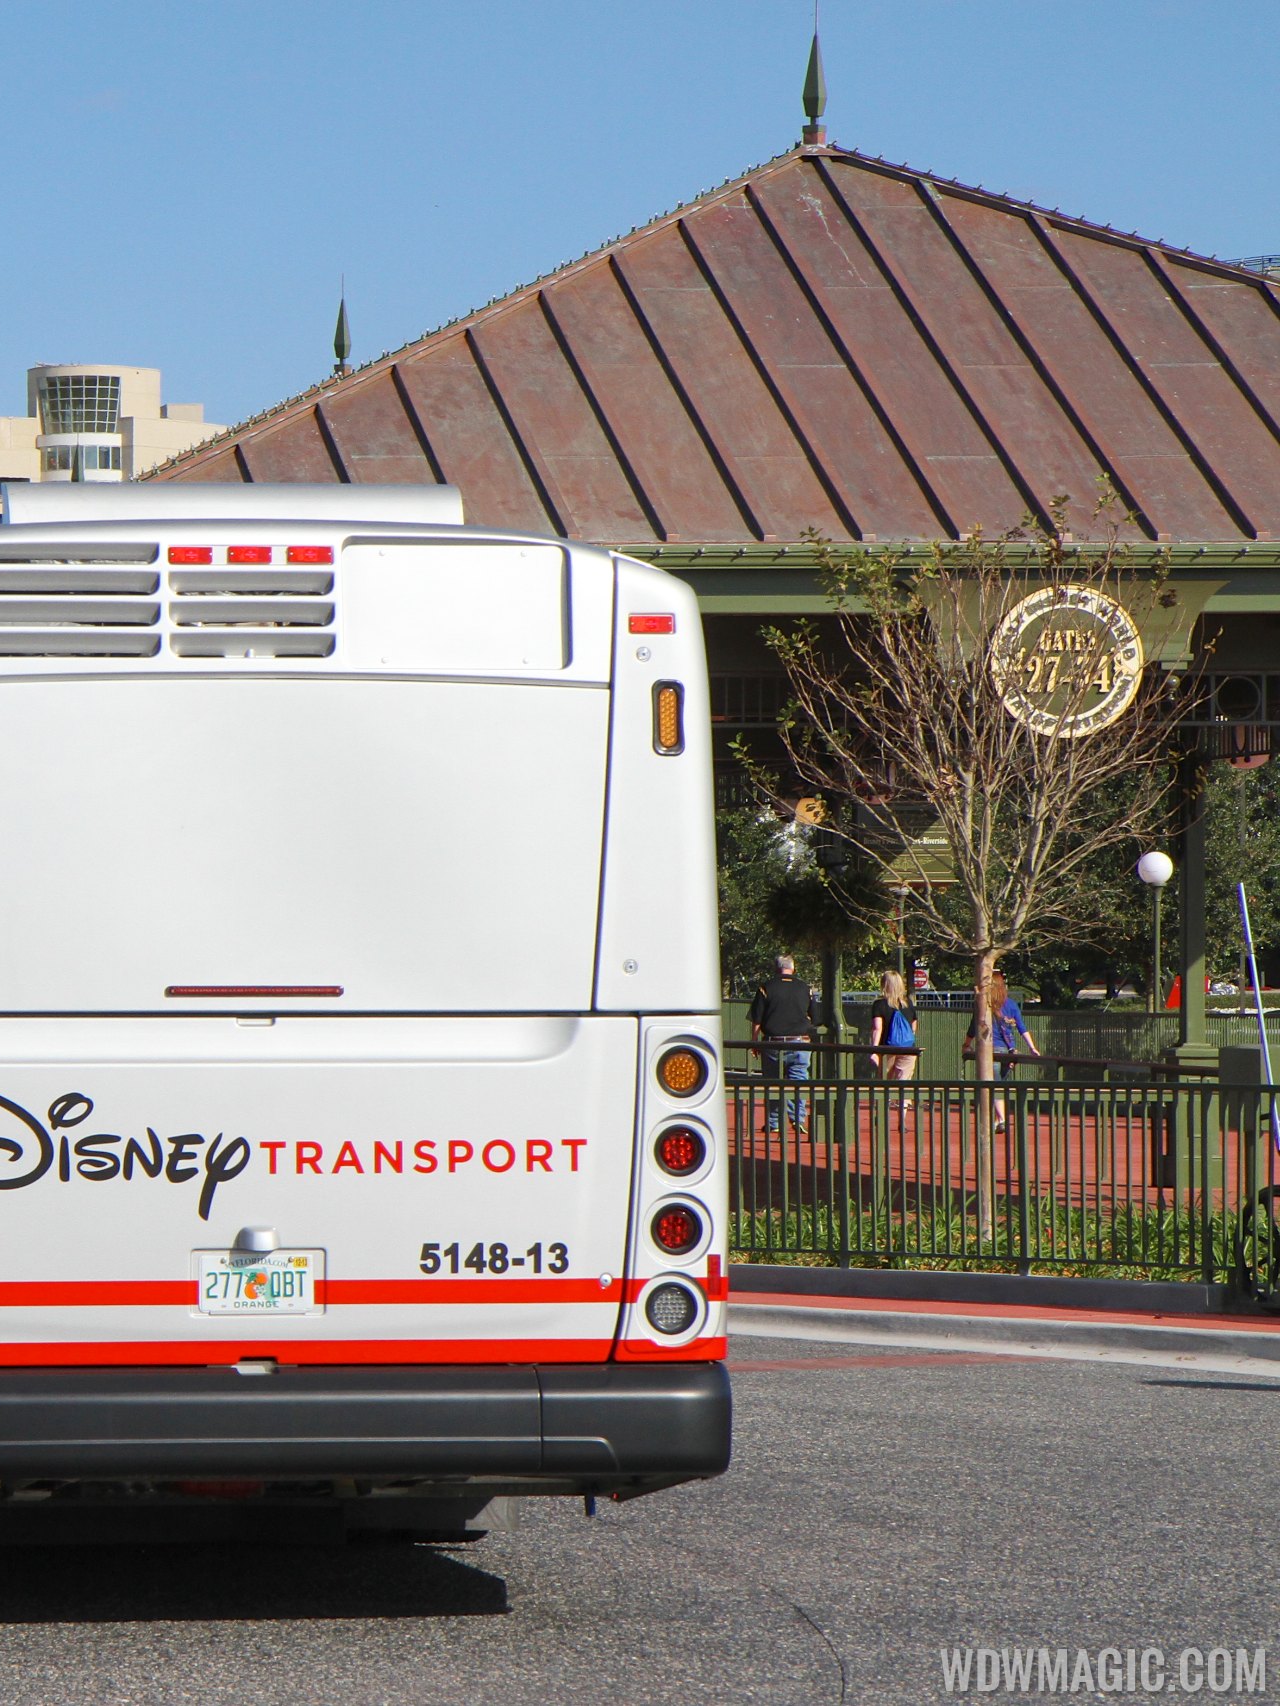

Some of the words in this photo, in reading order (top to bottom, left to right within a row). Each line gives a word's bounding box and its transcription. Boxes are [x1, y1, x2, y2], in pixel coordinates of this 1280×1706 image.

[1038, 629, 1096, 651] GATES
[260, 1138, 588, 1176] TRANSPORT
[419, 1241, 569, 1274] 5148-13
[206, 1271, 243, 1299] 277
[270, 1271, 307, 1299] QBT
[233, 1300, 280, 1309] ORANGE
